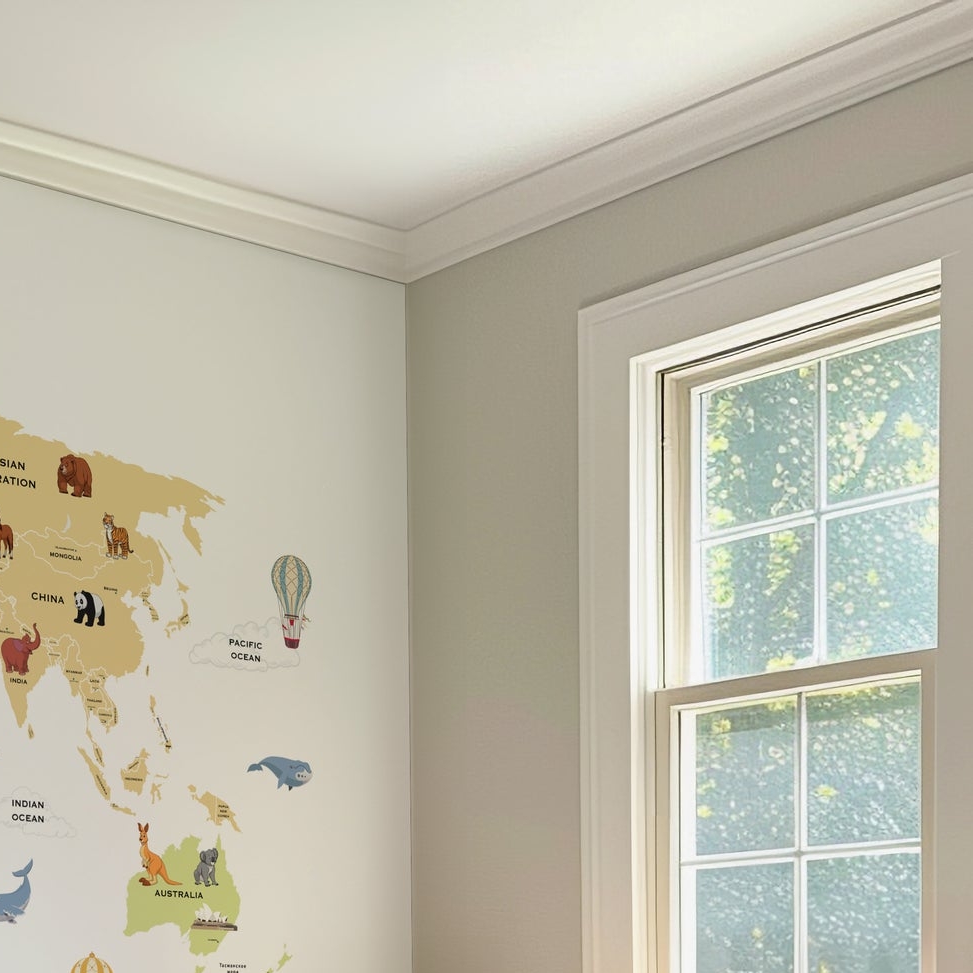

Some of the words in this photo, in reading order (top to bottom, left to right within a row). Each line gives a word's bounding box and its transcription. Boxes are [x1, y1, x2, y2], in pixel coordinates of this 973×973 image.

[50, 552, 82, 562] MONGOLIA
[31, 592, 65, 604] CHINA
[229, 639, 262, 650] PACIFIC
[231, 652, 261, 662] OCEAN
[11, 799, 44, 809] INDIAN
[11, 814, 45, 823] OCEAN
[155, 890, 203, 899] AUSTRALIA
